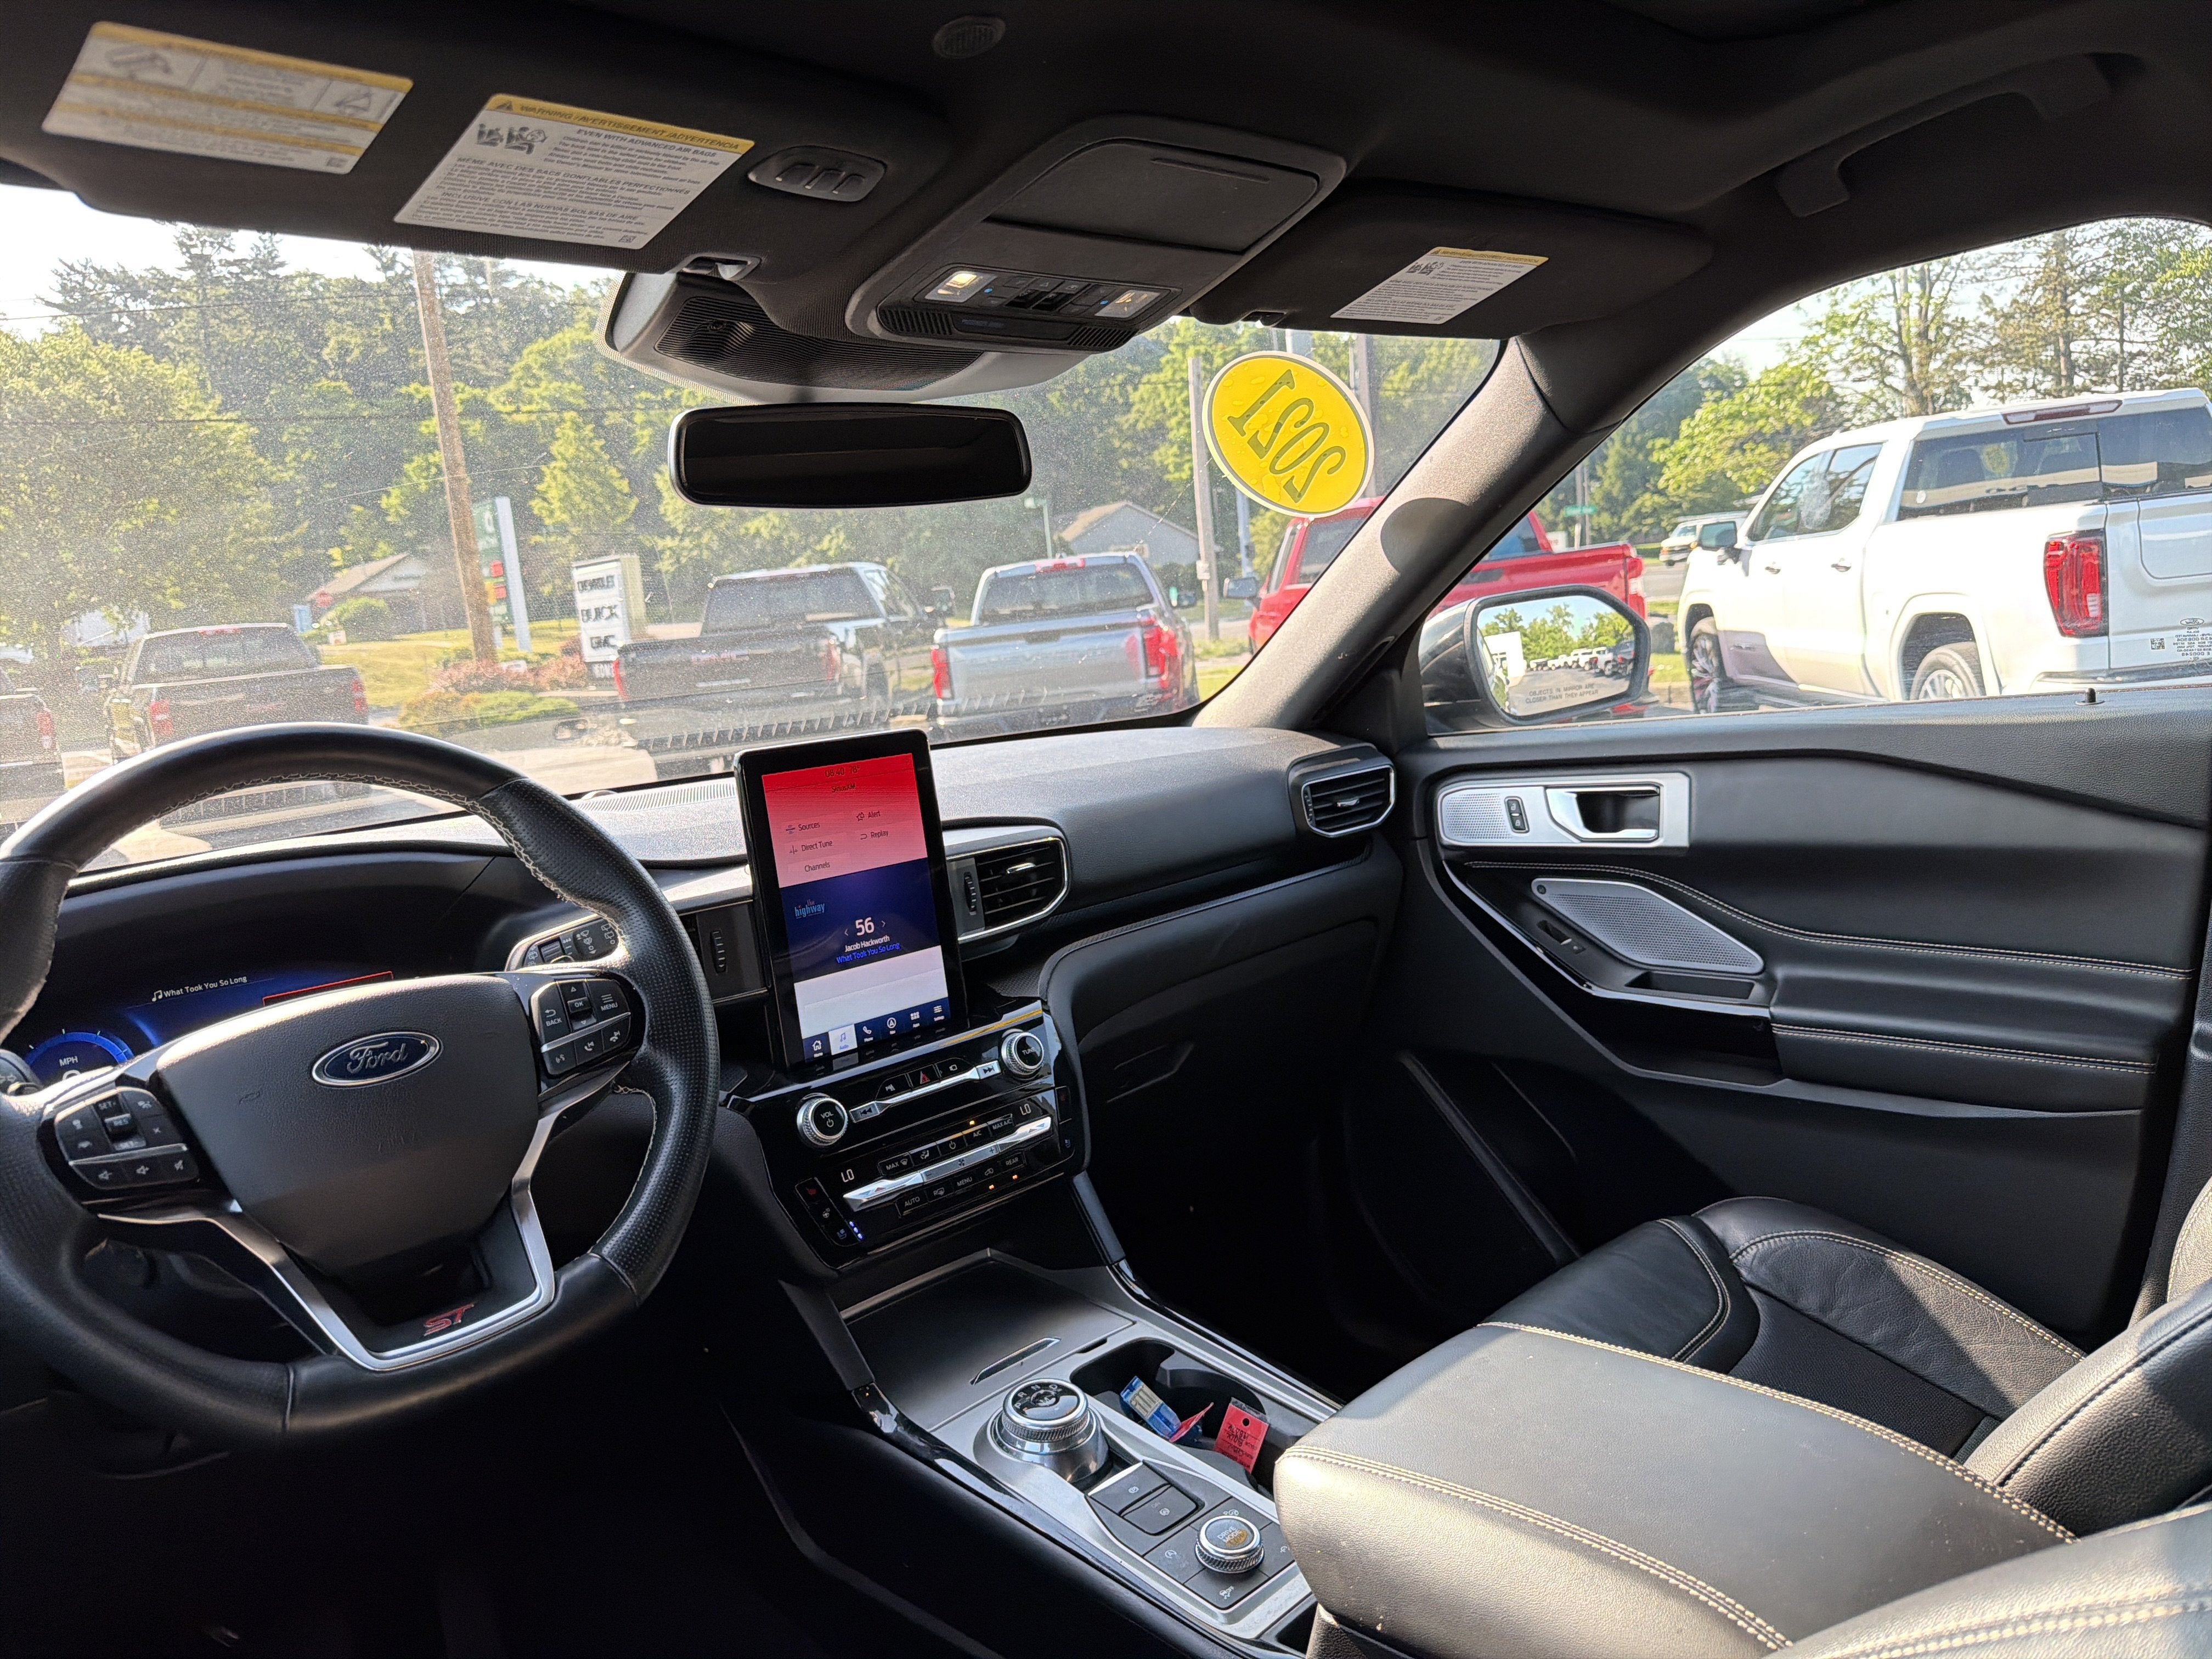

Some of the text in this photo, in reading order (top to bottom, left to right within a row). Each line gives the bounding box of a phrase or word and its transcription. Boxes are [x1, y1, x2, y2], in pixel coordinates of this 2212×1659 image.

[520, 105, 573, 119] WARNING
[577, 129, 602, 137] EVEN
[603, 133, 628, 142] WITH
[628, 138, 675, 150] ADVANCED
[581, 605, 619, 623] BUICK
[1529, 688, 1553, 697] OBJECTS
[1579, 689, 1599, 697] APPEAR
[868, 810, 881, 819] Alert
[798, 822, 820, 831] Sources
[871, 830, 889, 839] Replay
[801, 840, 833, 852] Direct Tune
[804, 861, 831, 872] Channels
[794, 903, 825, 918] highway
[855, 917, 874, 936] 56
[844, 935, 890, 952] Jacob Hackworth
[837, 955, 853, 964] What
[853, 951, 867, 959] Took
[886, 943, 901, 952] Long
[164, 989, 184, 997] What
[184, 985, 203, 993] Took
[229, 977, 247, 985] Long
[601, 1002, 618, 1011] MENU
[546, 1017, 562, 1027] BACK
[1022, 1047, 1038, 1056] TUNE
[59, 1056, 78, 1066] MPH
[347, 1041, 408, 1074] Ford
[1020, 1104, 1031, 1115] LO
[992, 1122, 1003, 1130] MAX
[886, 1162, 899, 1170] MAX
[1006, 1158, 1019, 1166] REAR
[841, 1169, 855, 1182] LO
[957, 1176, 973, 1187] MENU
[905, 1196, 920, 1207] AUTO
[424, 1303, 475, 1336] ST
[1217, 1526, 1238, 1539] DRIVE
[1223, 1530, 1242, 1543] MODE
